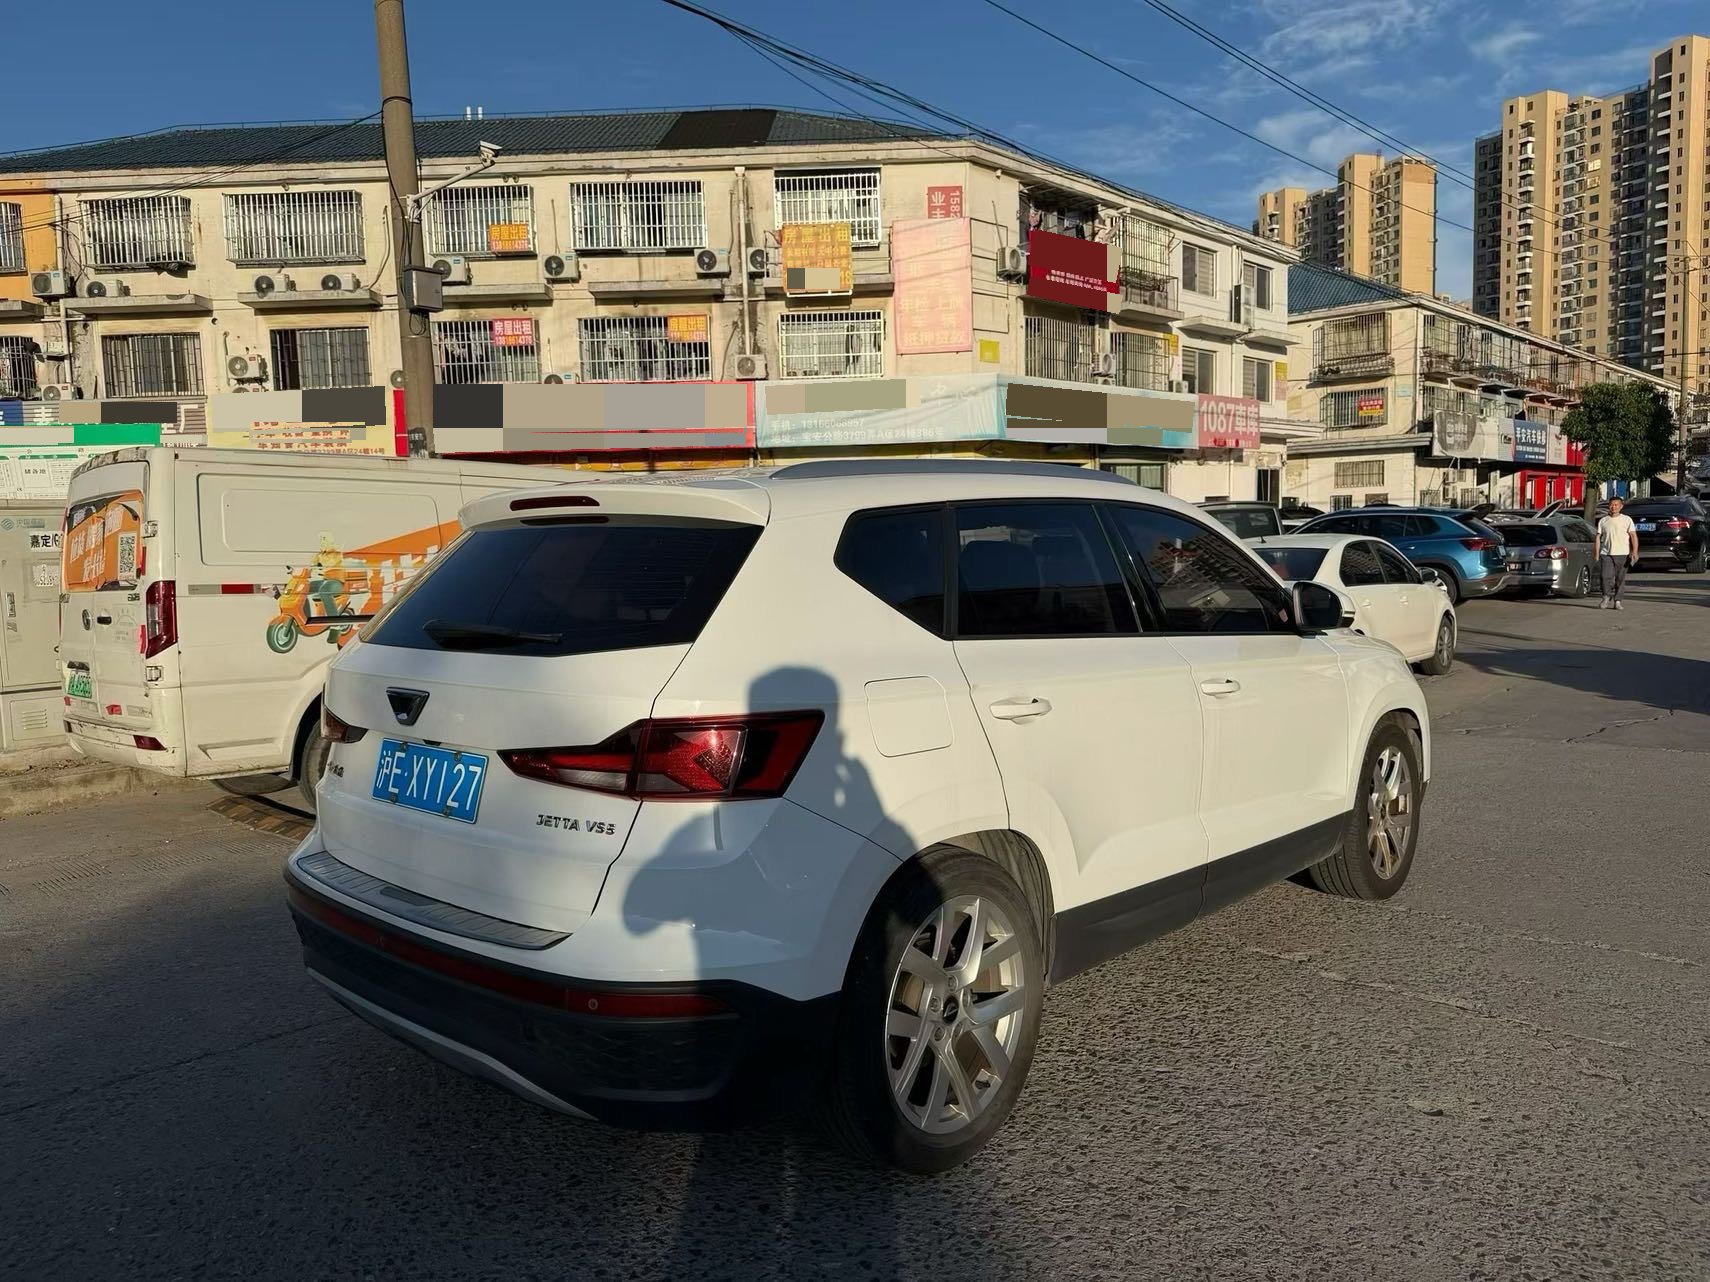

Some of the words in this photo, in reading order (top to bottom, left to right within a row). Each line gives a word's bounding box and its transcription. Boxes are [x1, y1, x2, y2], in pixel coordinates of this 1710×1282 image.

[491, 226, 528, 240] 房屋出租
[784, 226, 849, 243] 房屋出租
[495, 321, 532, 335] 房屋出租
[670, 317, 706, 331] 房屋出租
[375, 749, 482, 811] 沪E·XY127
[536, 814, 580, 832] JETTA
[586, 820, 616, 836] VS5
